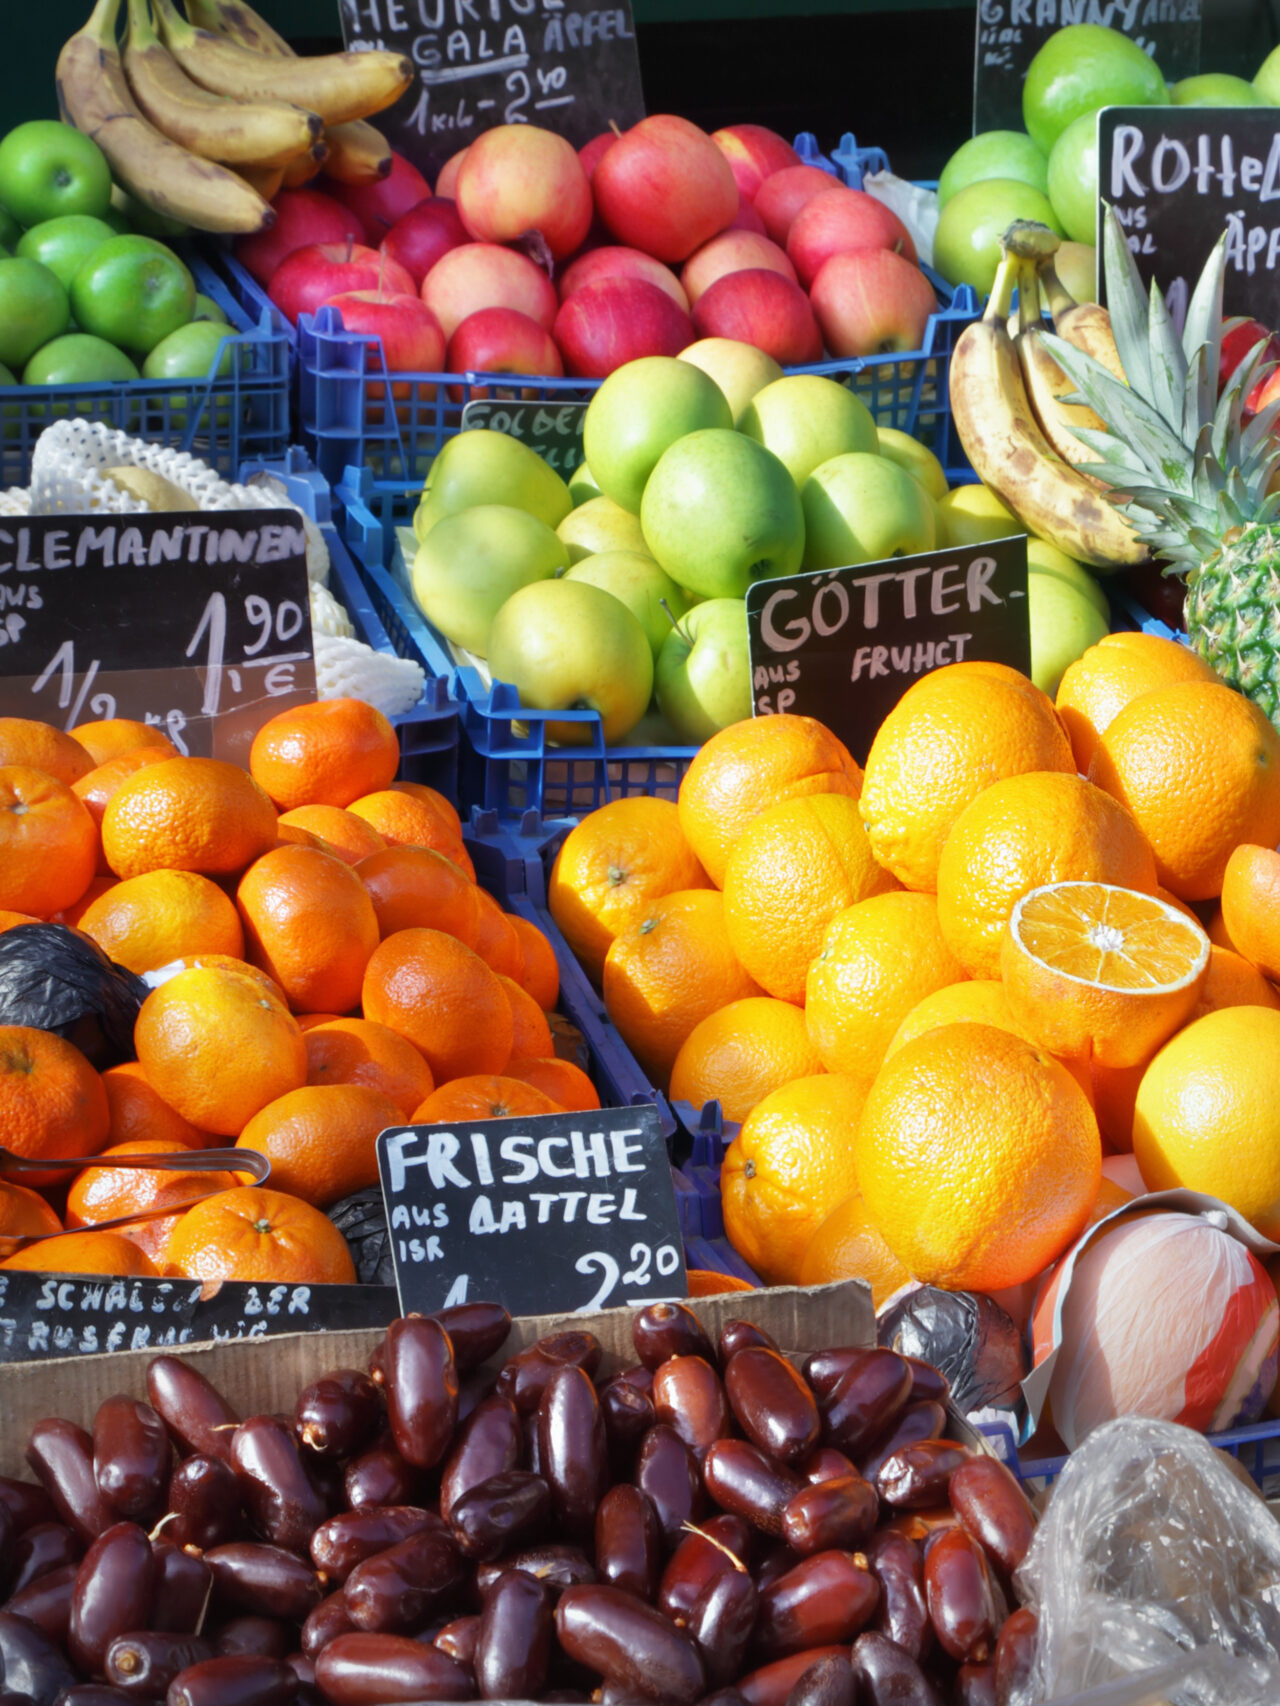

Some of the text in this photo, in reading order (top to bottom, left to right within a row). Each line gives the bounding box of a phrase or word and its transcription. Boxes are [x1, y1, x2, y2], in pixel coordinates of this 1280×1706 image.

[412, 9, 634, 66] GALA ÄPFEL
[1111, 204, 1148, 229] US
[464, 405, 587, 437] GOLDE
[753, 659, 801, 691] AUS
[757, 688, 797, 715] SP
[385, 1128, 647, 1193] FRISCHE
[391, 1202, 450, 1231] AUS
[398, 1234, 446, 1264] ISR
